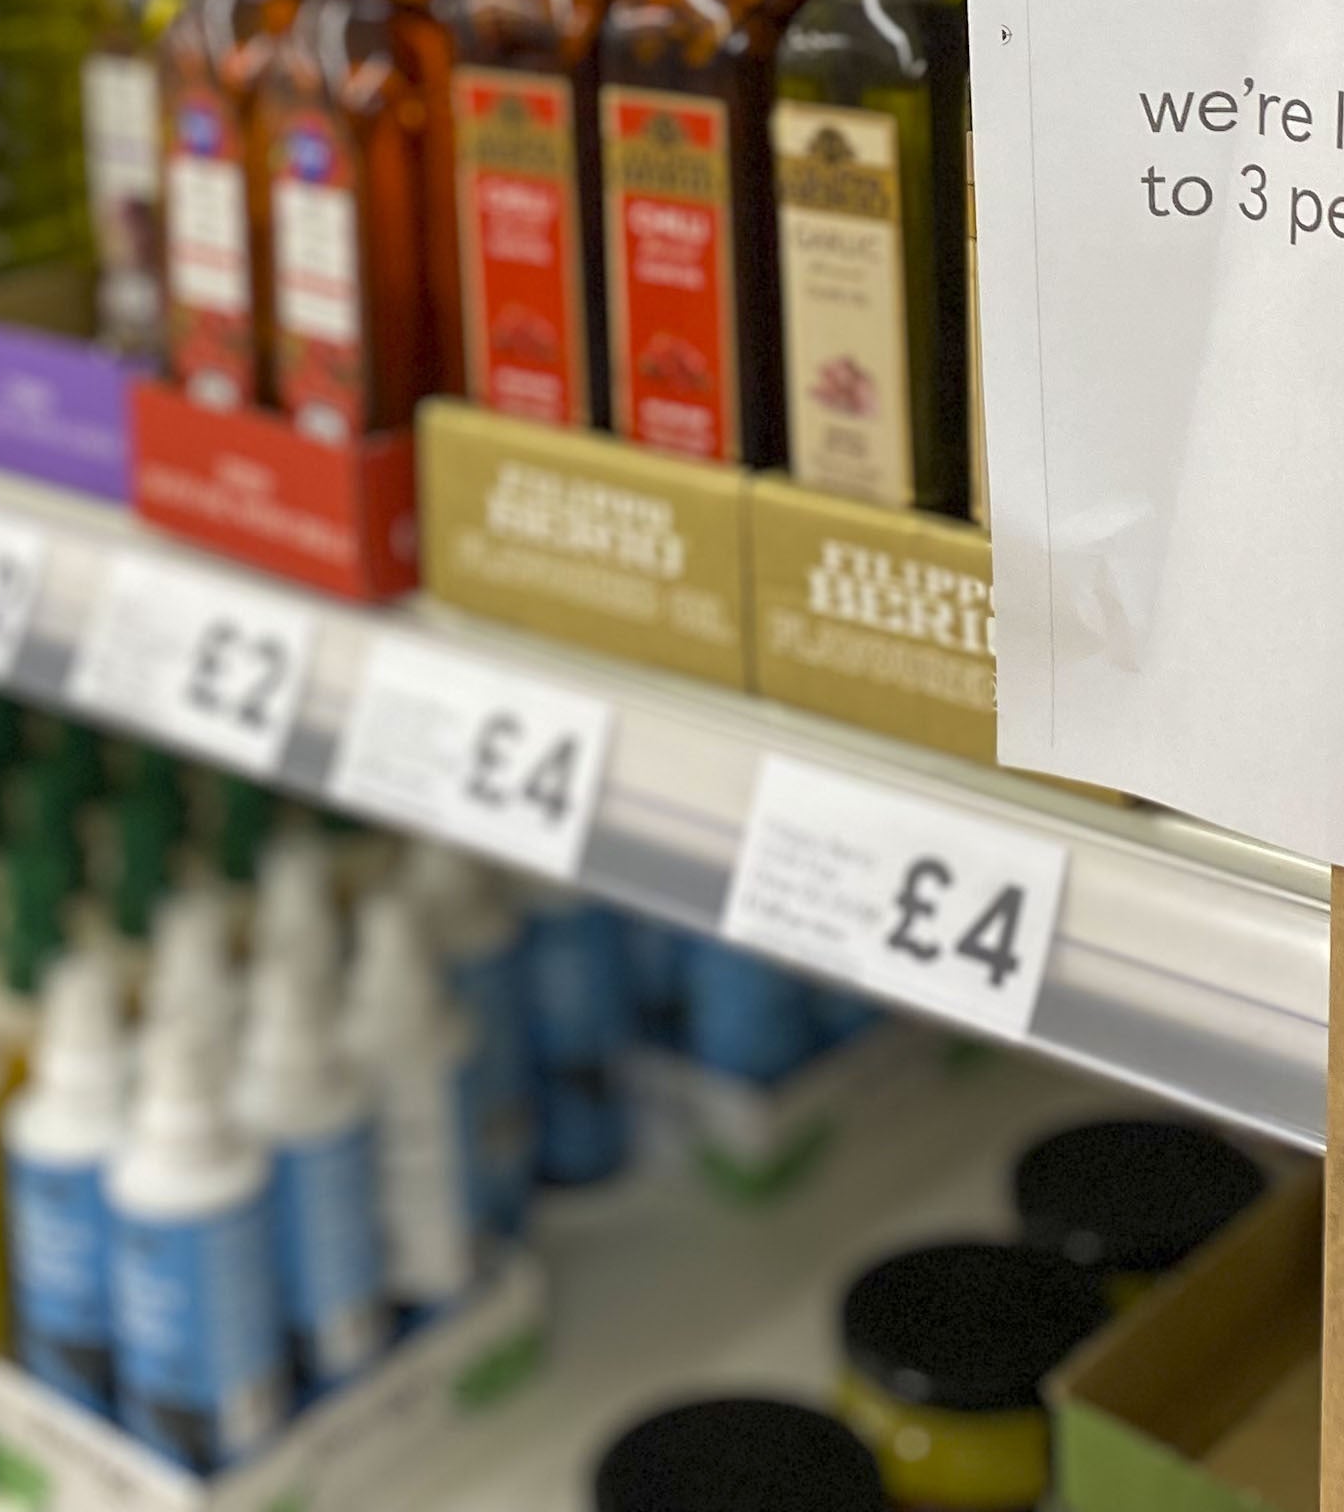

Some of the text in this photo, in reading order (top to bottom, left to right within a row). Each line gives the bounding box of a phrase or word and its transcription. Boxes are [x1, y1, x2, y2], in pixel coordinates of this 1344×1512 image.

[1140, 164, 1214, 218] to
[1238, 163, 1269, 222] 3
[808, 565, 997, 659] BERI
[820, 537, 995, 610] FILIPP
[184, 615, 291, 733] £2
[461, 709, 582, 829] £4
[884, 853, 1026, 987] £4
